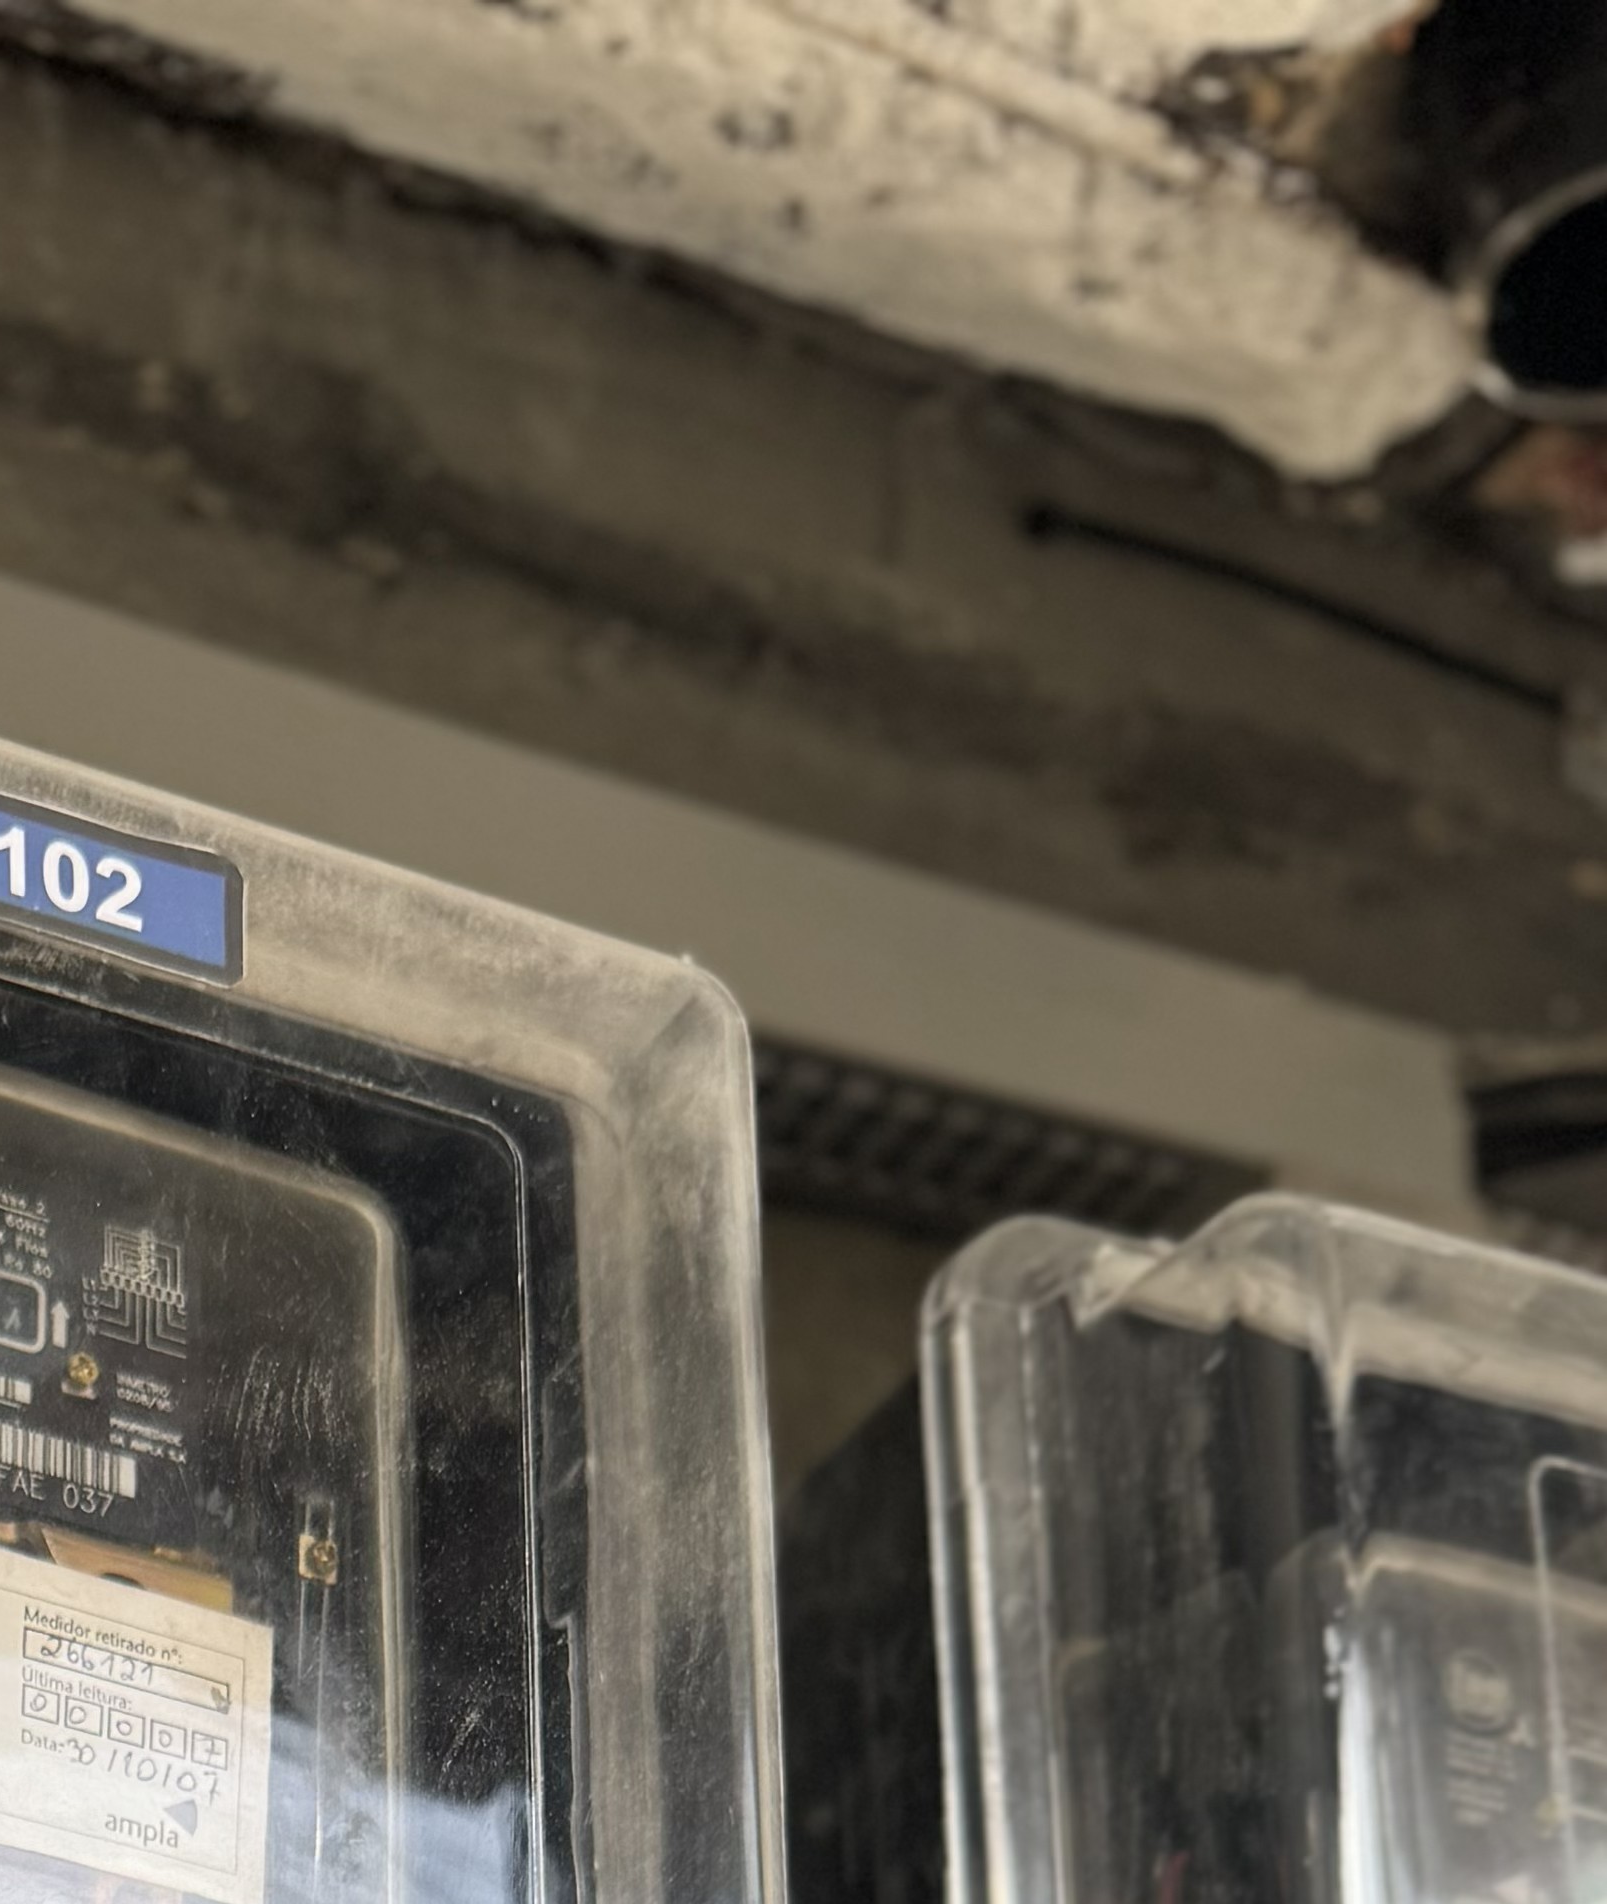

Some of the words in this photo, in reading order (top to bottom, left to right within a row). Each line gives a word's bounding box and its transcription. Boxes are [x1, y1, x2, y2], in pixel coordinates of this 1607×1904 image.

[34, 1201, 45, 1215] 2
[14, 1235, 48, 1257] Fios
[63, 1483, 114, 1518] 037
[23, 1606, 90, 1637] Medidor
[94, 1631, 156, 1656] retirado
[21, 1665, 73, 1696] Última
[78, 1681, 132, 1710] leitura:
[21, 1728, 65, 1753] Data:
[104, 1811, 179, 1849] ampla
